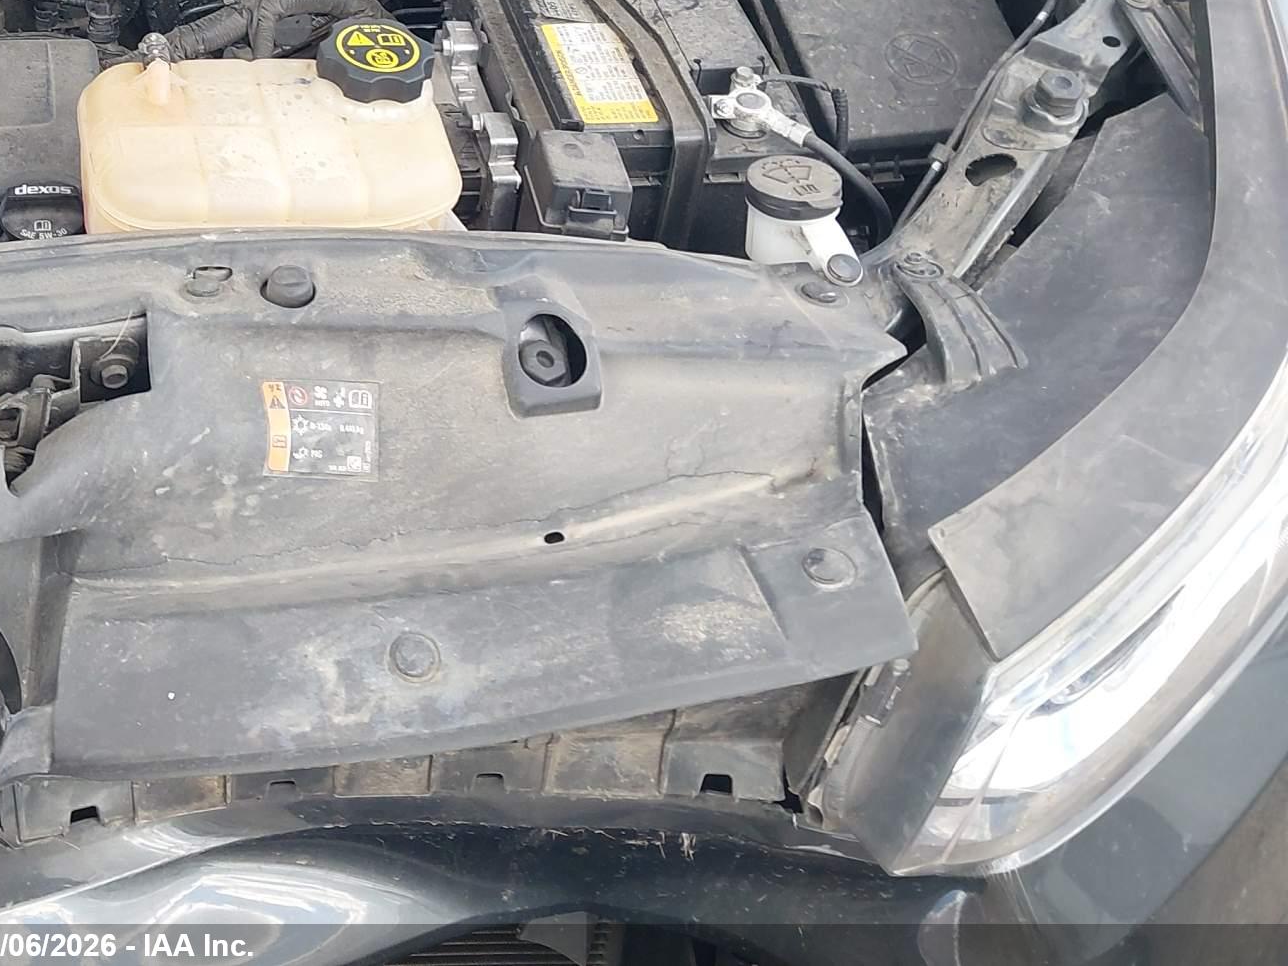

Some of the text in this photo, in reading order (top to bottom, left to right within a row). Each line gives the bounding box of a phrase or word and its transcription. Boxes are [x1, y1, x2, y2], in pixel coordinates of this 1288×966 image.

[14, 183, 74, 196] dexos
[20, 227, 68, 240] SAE 5W-30
